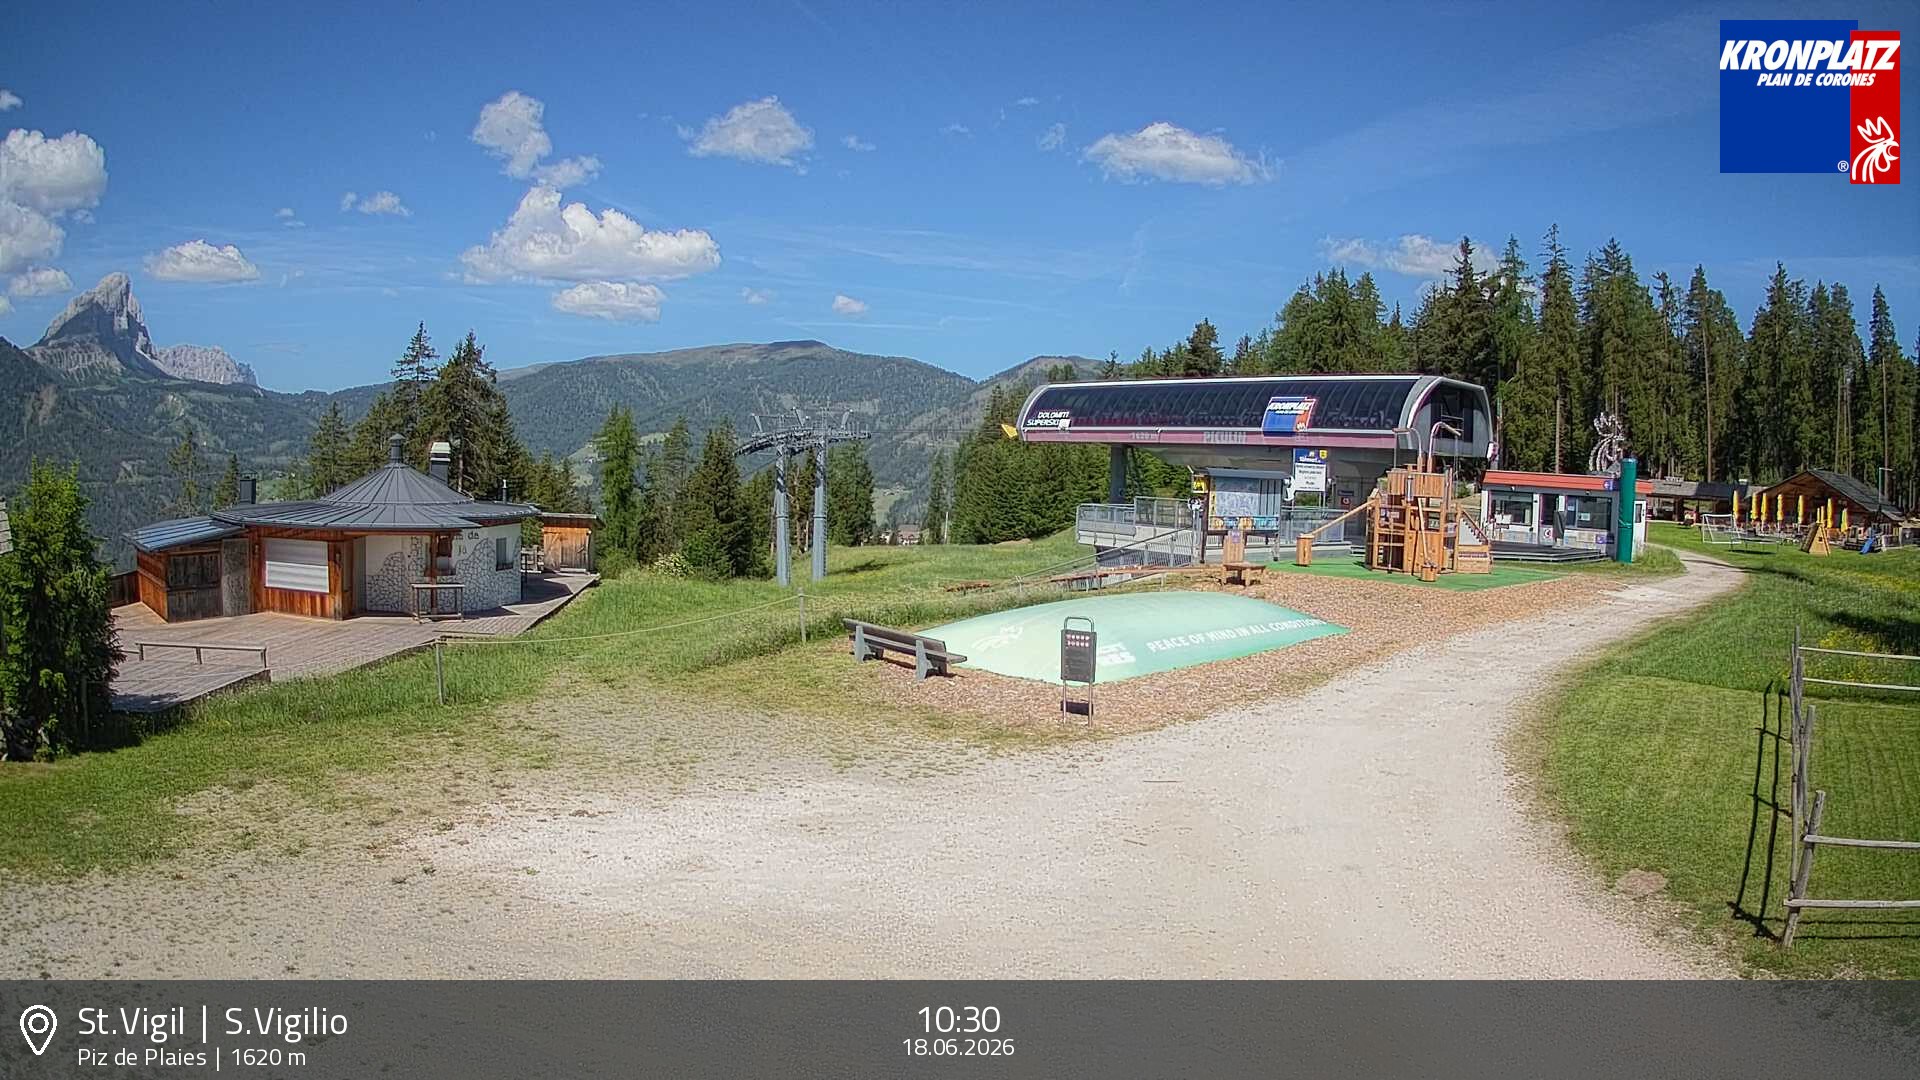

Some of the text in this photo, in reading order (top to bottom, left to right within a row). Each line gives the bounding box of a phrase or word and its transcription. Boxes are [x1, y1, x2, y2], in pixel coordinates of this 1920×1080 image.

[1146, 636, 1189, 653] PEACE
[1188, 633, 1205, 644] OF
[1206, 628, 1237, 641] MIND
[1236, 625, 1251, 637] IN
[1250, 623, 1271, 635] ALL
